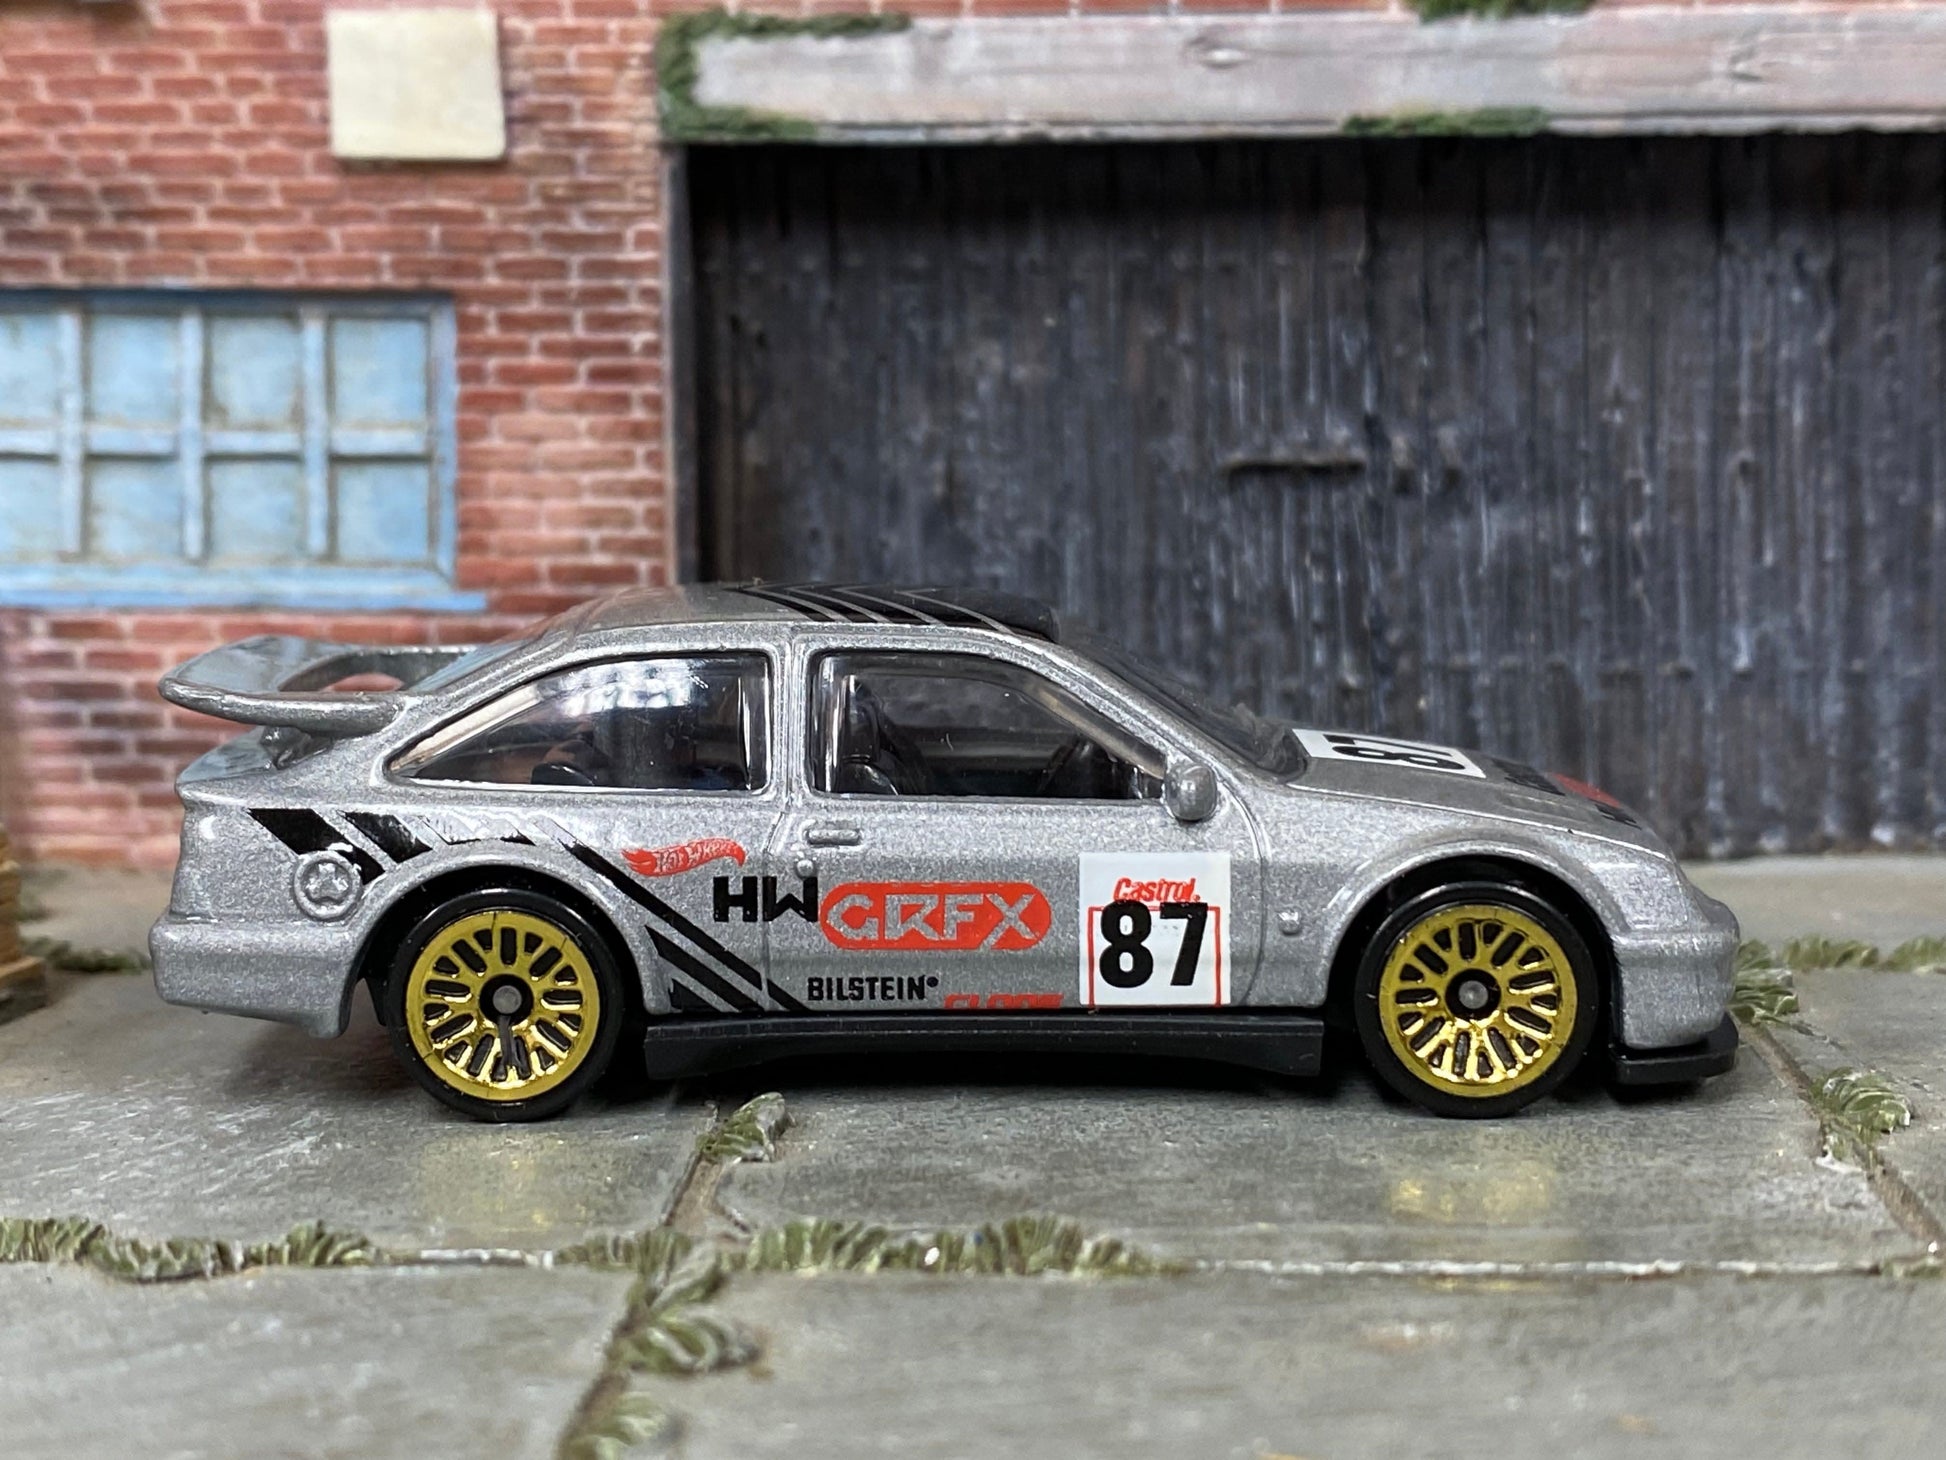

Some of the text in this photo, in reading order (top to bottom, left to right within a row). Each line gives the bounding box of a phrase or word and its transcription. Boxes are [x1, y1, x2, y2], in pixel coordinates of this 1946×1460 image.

[712, 875, 1037, 950] HW GRFX
[1099, 900, 1208, 988] 87
[807, 976, 926, 1001] BILSTEIN
